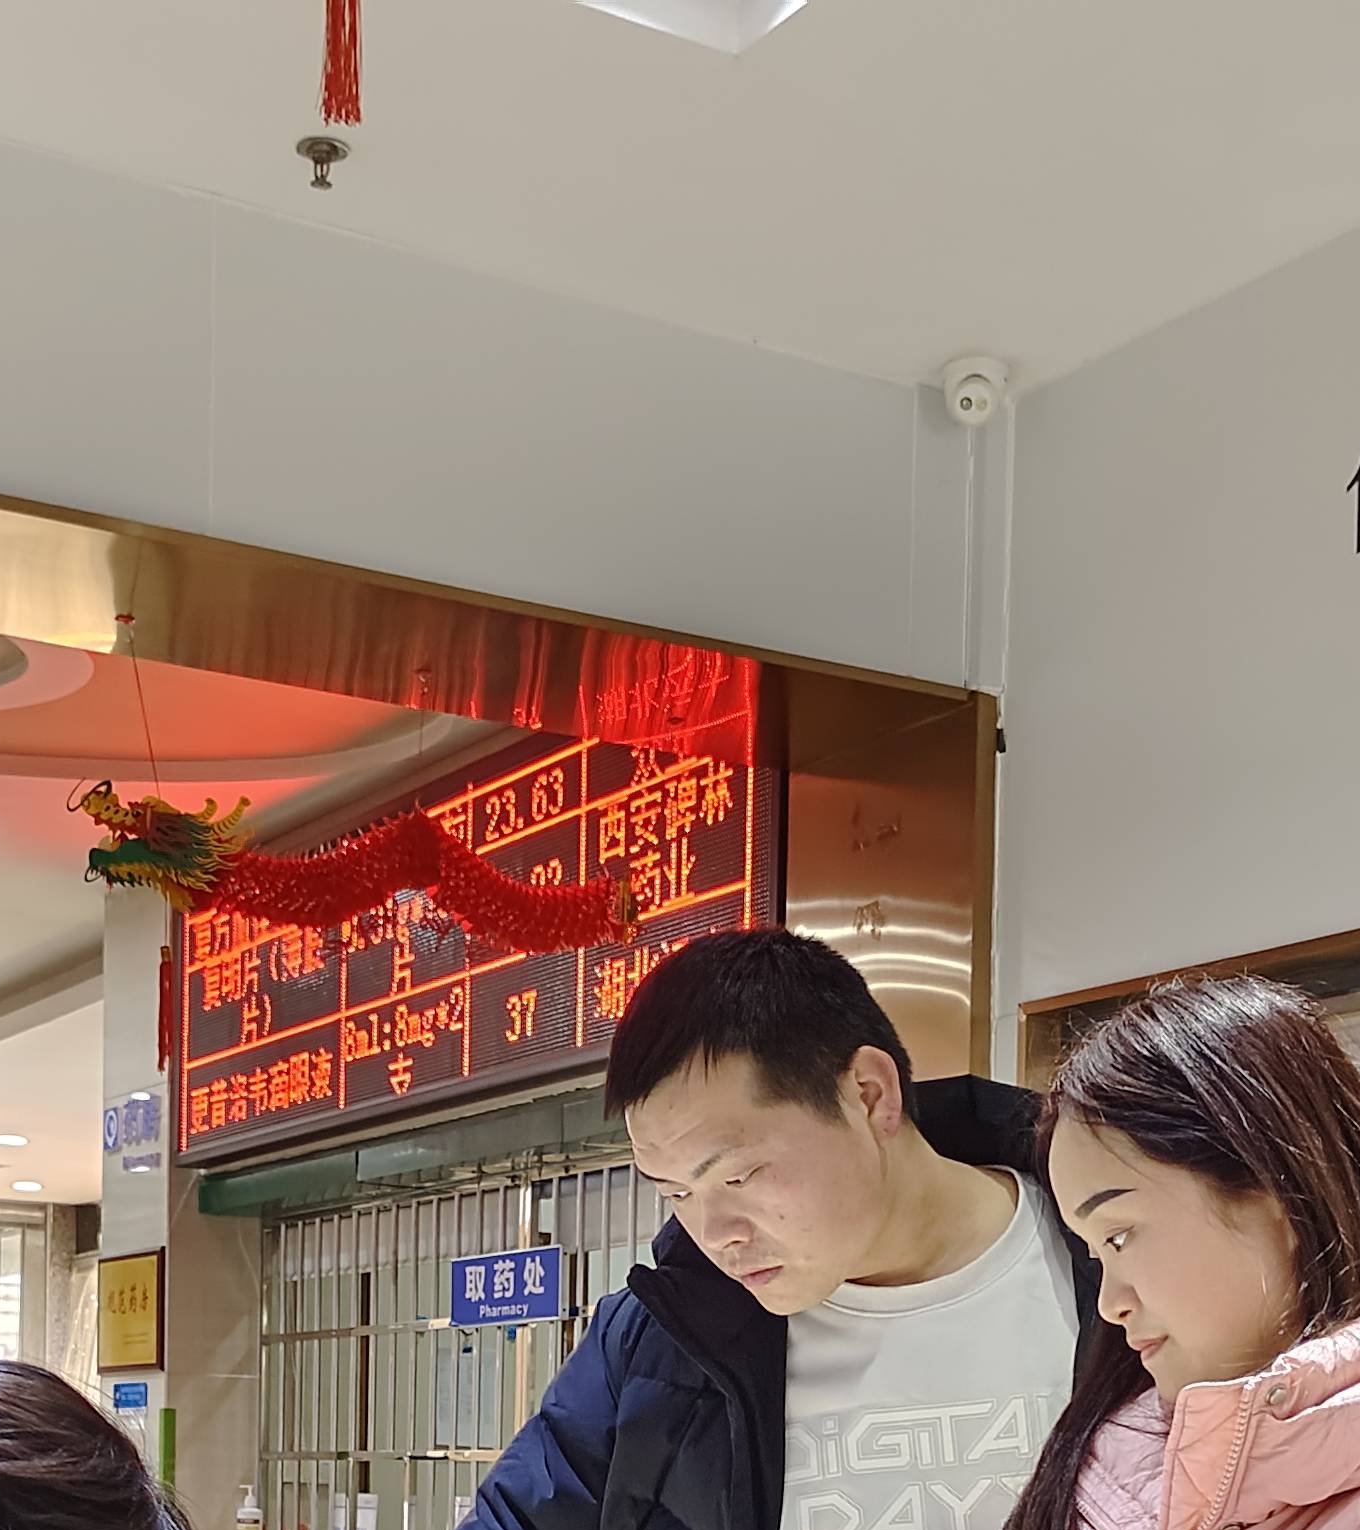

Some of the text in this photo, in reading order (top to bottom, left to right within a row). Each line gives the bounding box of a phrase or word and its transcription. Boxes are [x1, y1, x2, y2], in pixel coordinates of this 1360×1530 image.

[506, 989, 538, 1042] 37
[464, 1255, 545, 1302] 取药处
[479, 1303, 529, 1318] Pharmacy
